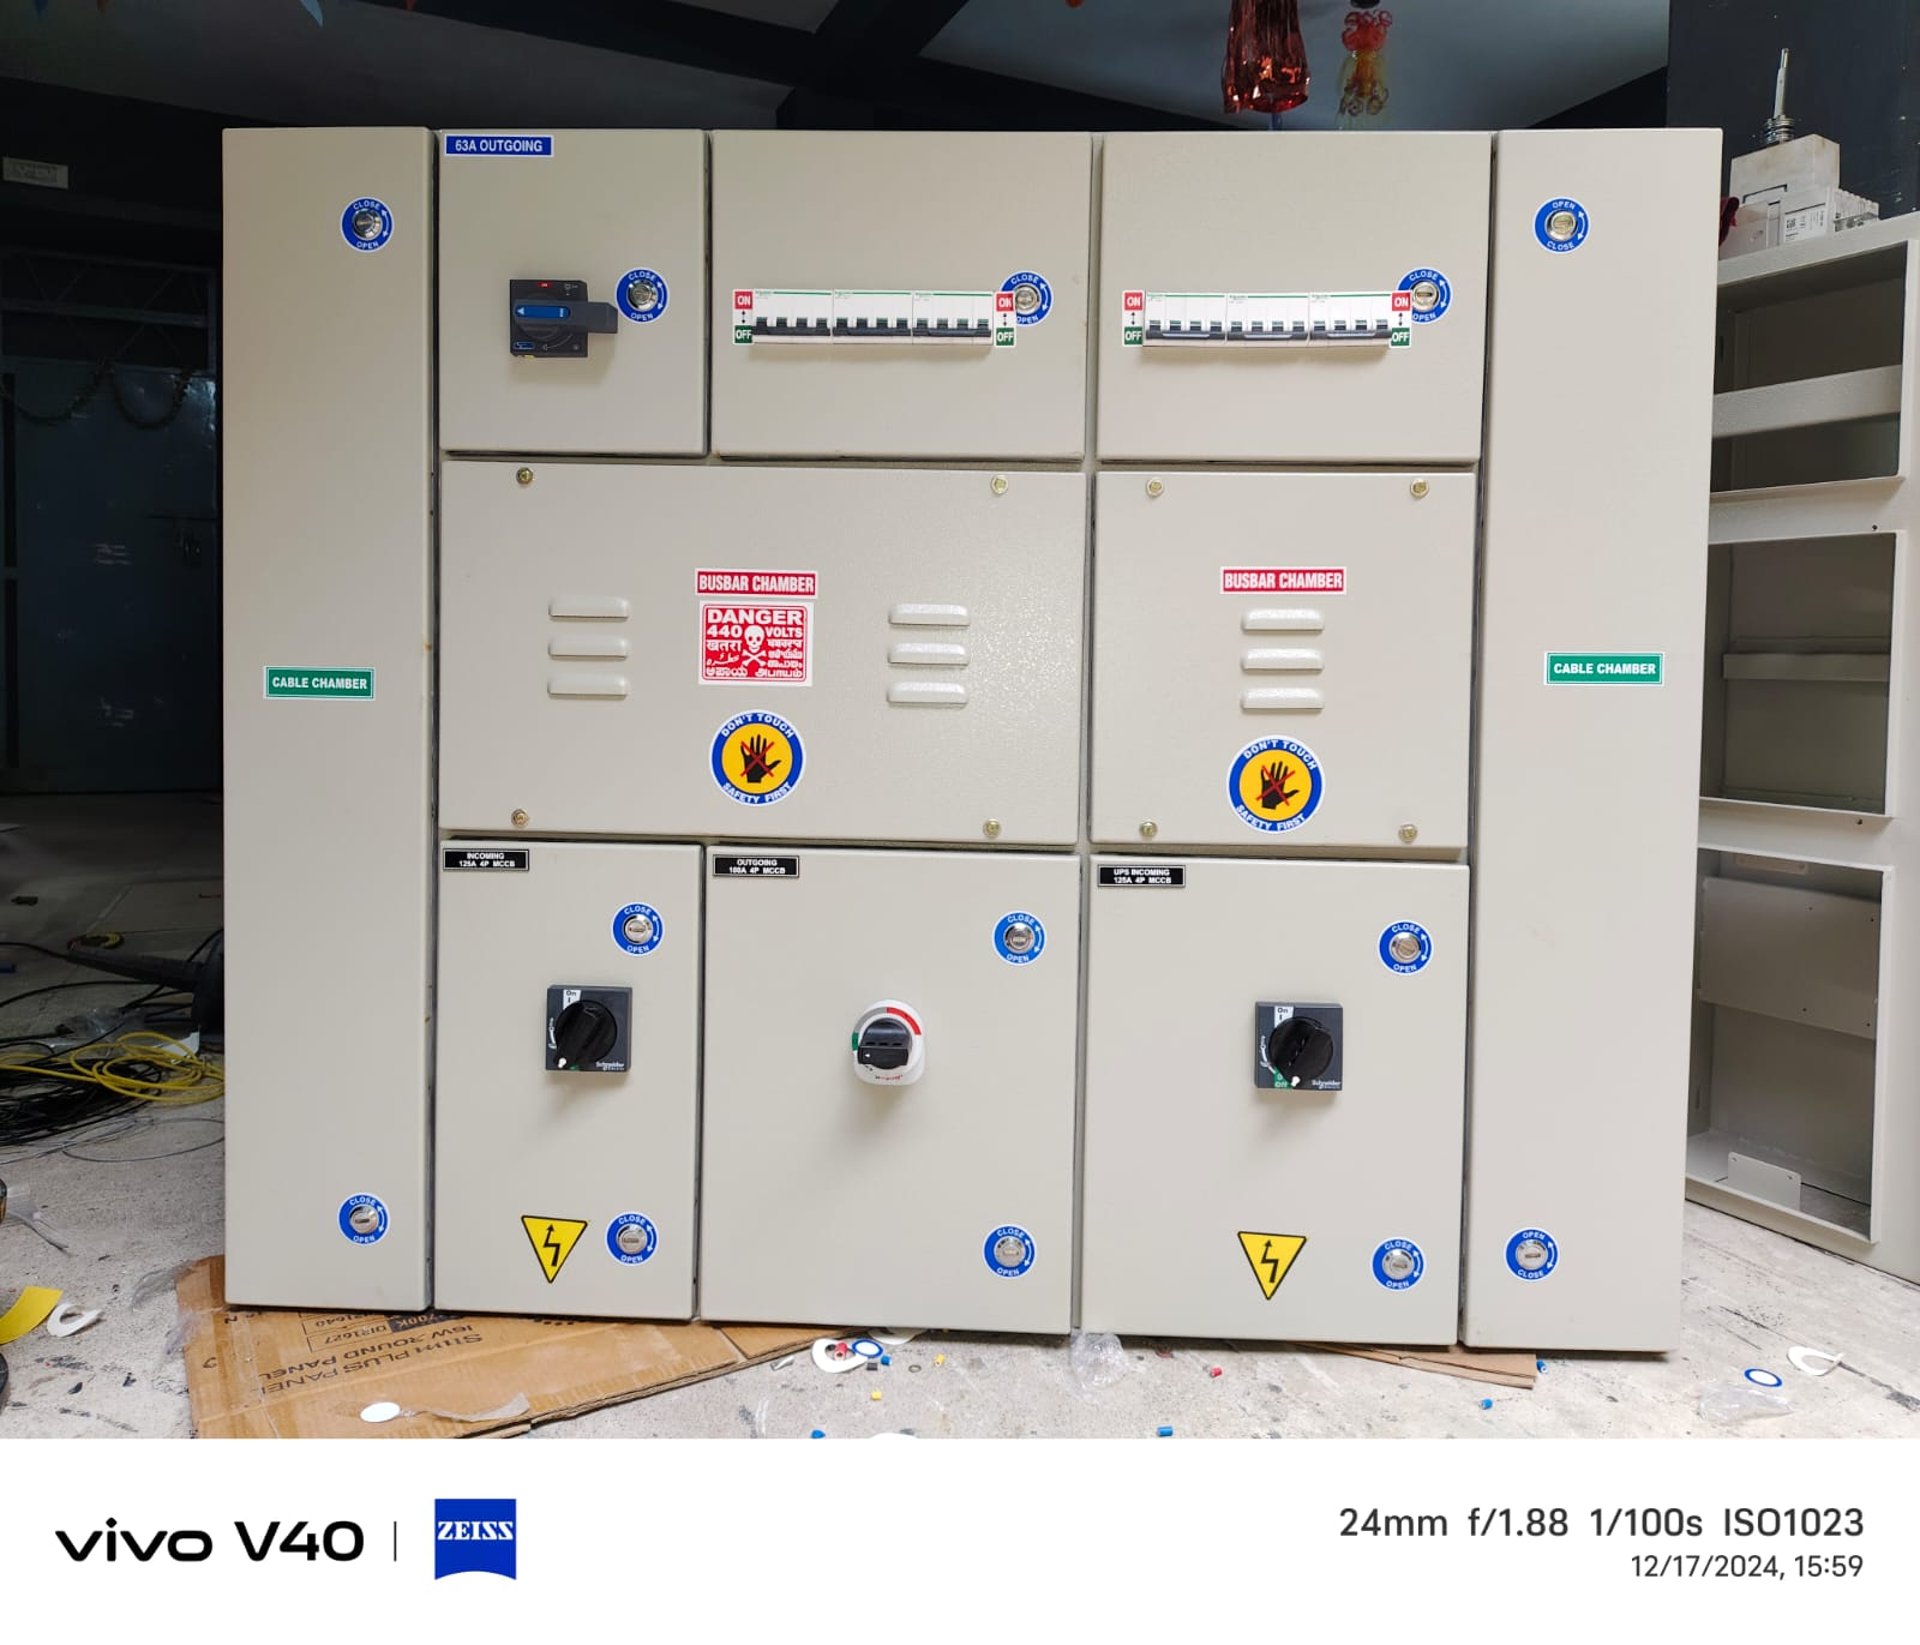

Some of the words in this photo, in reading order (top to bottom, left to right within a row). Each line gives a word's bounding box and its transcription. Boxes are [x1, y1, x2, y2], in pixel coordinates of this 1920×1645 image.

[455, 139, 477, 152] 63A
[479, 139, 543, 152] OUTGOING
[353, 200, 381, 210] CLOSE
[1552, 200, 1576, 210] OPEN
[356, 241, 379, 249] OPEN
[1547, 240, 1574, 250] CLOSE
[628, 271, 656, 281] CLOSE
[1010, 273, 1038, 284] CLOSE
[1409, 271, 1438, 281] CLOSE
[737, 295, 751, 306] ON
[998, 297, 1012, 307] ON
[1126, 296, 1140, 306] ON
[1394, 297, 1408, 308] ON
[630, 312, 653, 321] OPEN
[735, 330, 752, 340] OFF
[997, 331, 1014, 342] OFF
[1125, 331, 1142, 341] OFF
[1392, 332, 1409, 342] OFF
[699, 574, 749, 591] BUSBAR
[752, 575, 814, 592] CHAMBER
[1224, 572, 1276, 588] BUSBAR
[1279, 572, 1342, 588] CHAMBER
[707, 609, 803, 625] DANGER
[706, 624, 742, 638] 440
[765, 627, 803, 638] VOLTS
[1554, 663, 1594, 674] CABLE
[1597, 663, 1656, 674] CHAMBER
[272, 677, 309, 688] CABLE
[311, 678, 367, 689] CHAMBER
[721, 714, 753, 737] DON'T
[757, 713, 795, 738] TOUCH
[1243, 740, 1279, 759] DON'T
[1282, 740, 1317, 770] TOUCH
[722, 782, 759, 803] SAFETY
[764, 781, 792, 802] FIRST
[1236, 804, 1272, 830] SAFETY
[1277, 813, 1305, 830] FIRST
[624, 905, 651, 915] CLOSE
[1392, 923, 1420, 933] CLOSE
[1393, 964, 1417, 972] OPEN
[619, 1215, 645, 1225] CLOSE
[1522, 1231, 1545, 1240] OPEN
[343, 1349, 410, 1373] PLUS
[257, 1355, 336, 1381] PANEL
